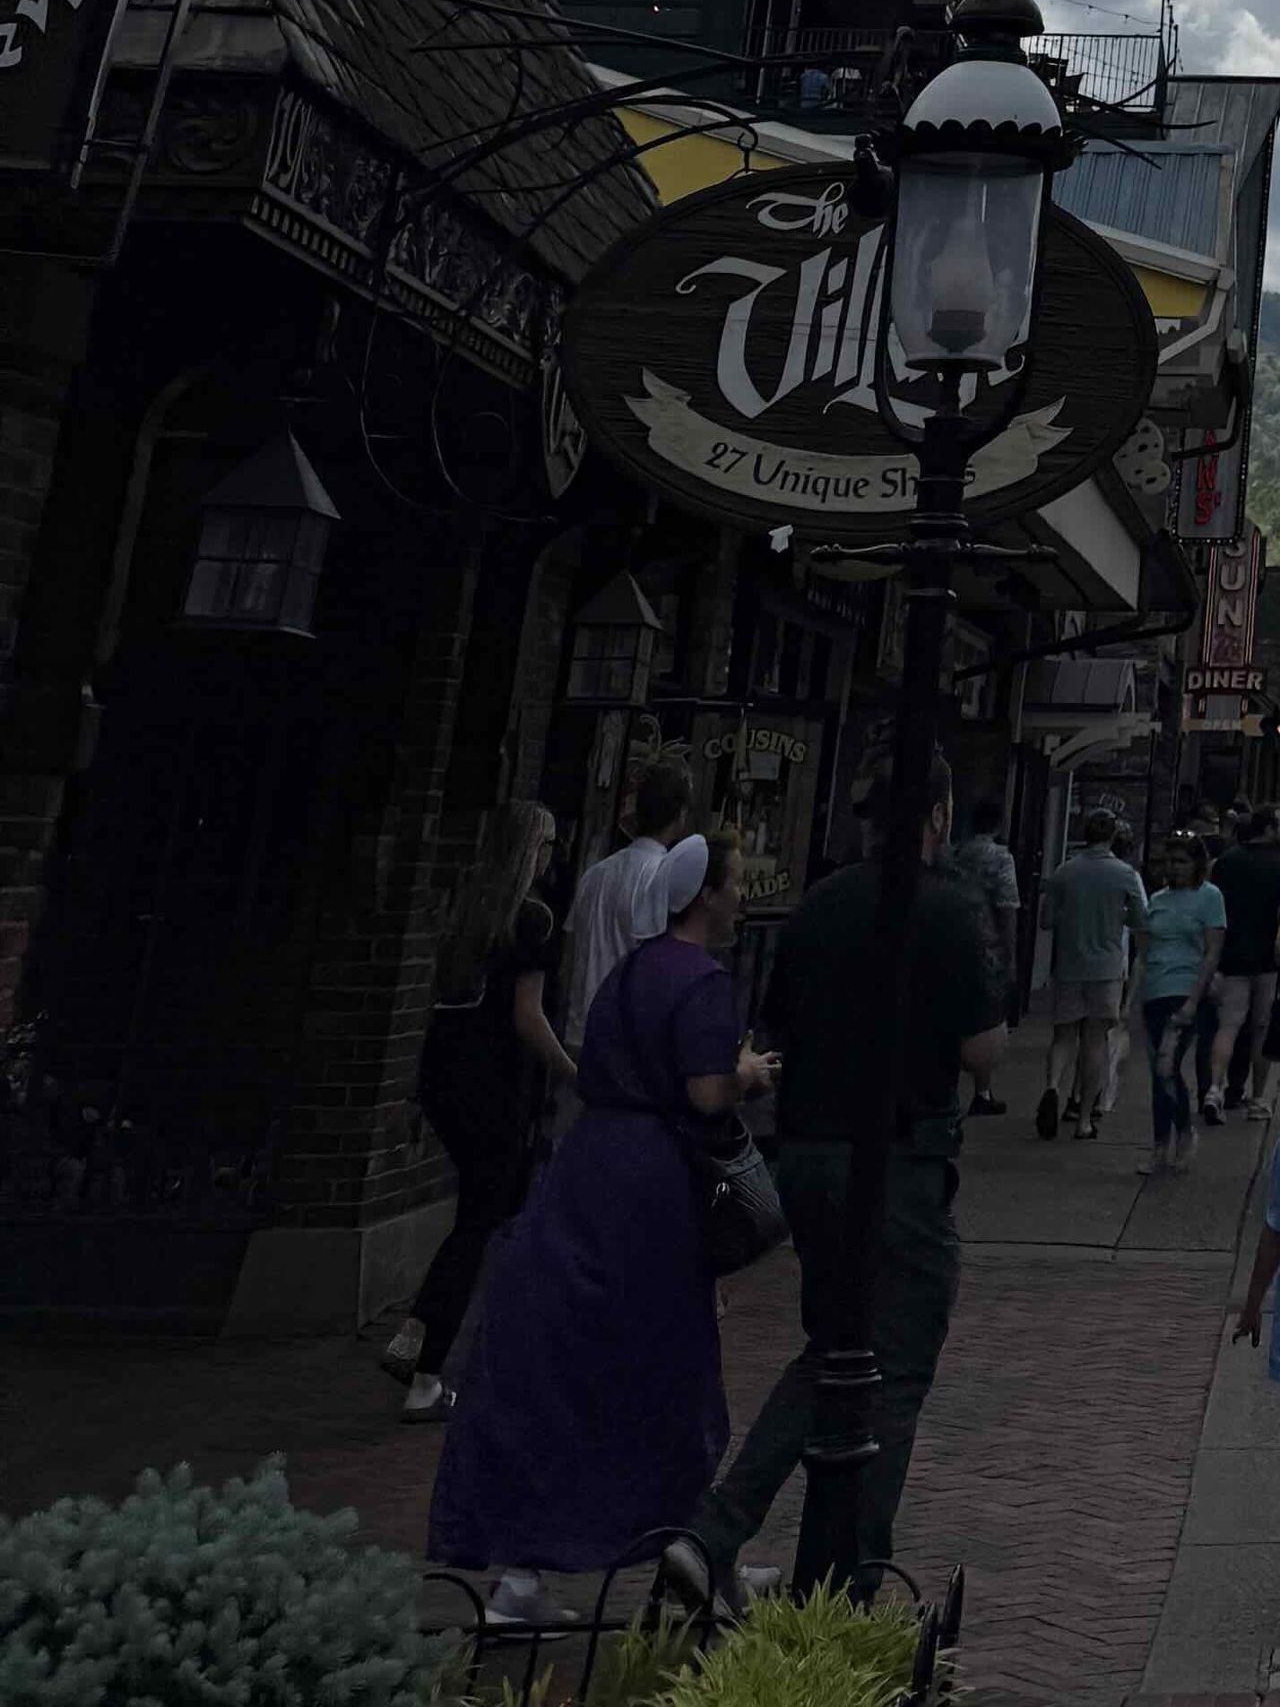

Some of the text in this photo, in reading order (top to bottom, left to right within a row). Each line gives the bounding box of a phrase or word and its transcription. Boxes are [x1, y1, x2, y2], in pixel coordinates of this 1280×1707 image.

[745, 181, 849, 239] The
[705, 442, 750, 473] 27
[752, 453, 870, 503] Unique
[1187, 669, 1263, 691] DINER
